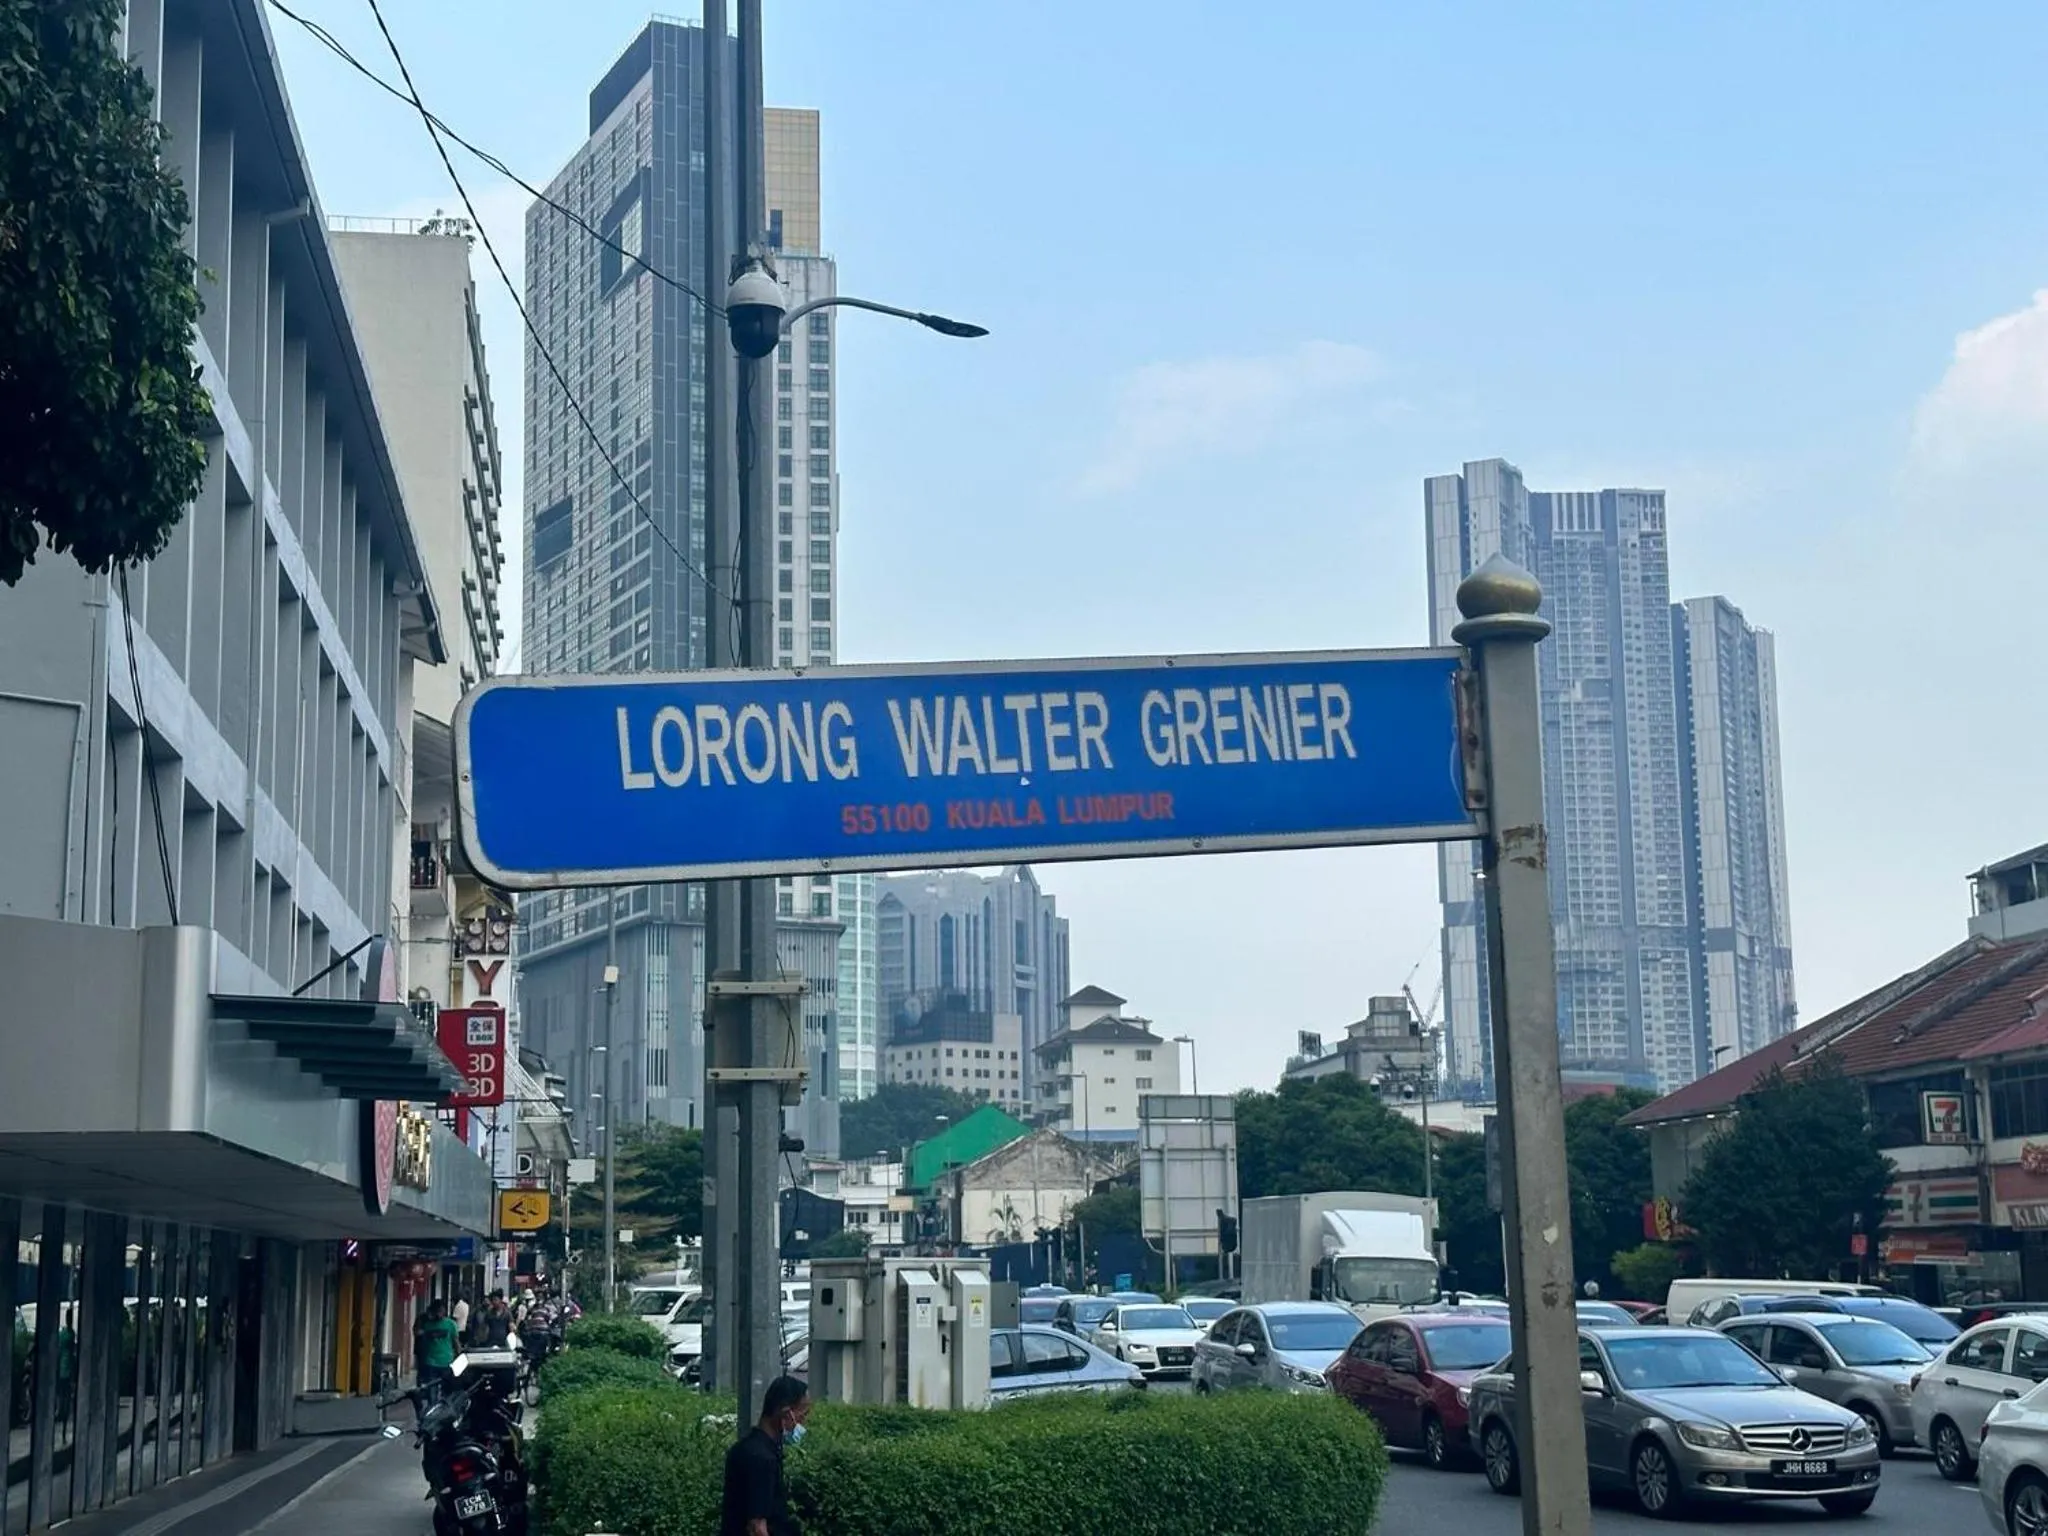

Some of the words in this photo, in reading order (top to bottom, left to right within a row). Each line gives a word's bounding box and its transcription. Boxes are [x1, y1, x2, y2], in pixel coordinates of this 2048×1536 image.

[617, 700, 859, 790] LORONG
[887, 691, 1114, 778] WALTER
[1140, 683, 1357, 767] GRENIER
[841, 801, 930, 835] 55100
[946, 797, 1046, 829] KUALA
[1058, 792, 1175, 825] LUMPUR
[467, 1052, 496, 1074] 3D
[467, 1076, 496, 1099] 3D
[1934, 1101, 1958, 1133] 7
[517, 1153, 533, 1175] D
